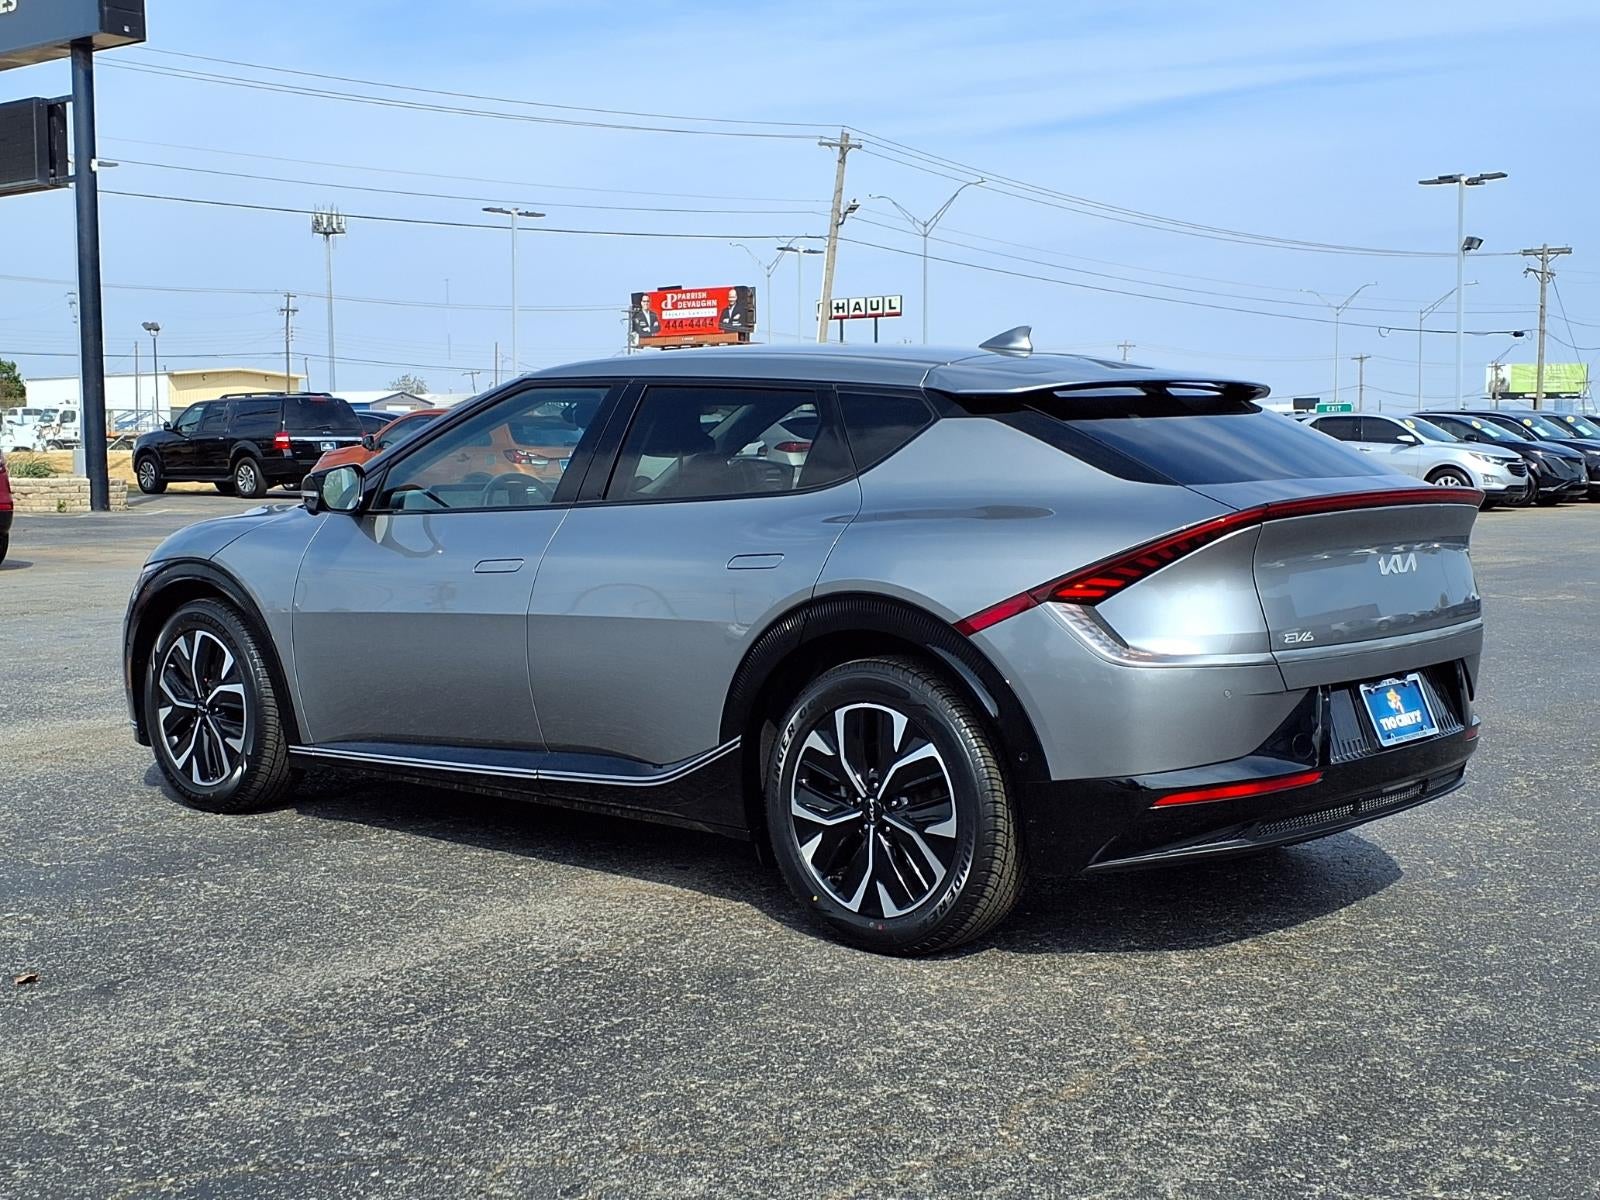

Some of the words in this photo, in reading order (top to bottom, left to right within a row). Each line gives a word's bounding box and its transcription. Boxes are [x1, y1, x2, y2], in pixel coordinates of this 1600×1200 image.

[677, 291, 707, 300] PARRISH
[677, 299, 718, 309] DEVAUGHN
[1284, 631, 1314, 643] EV6
